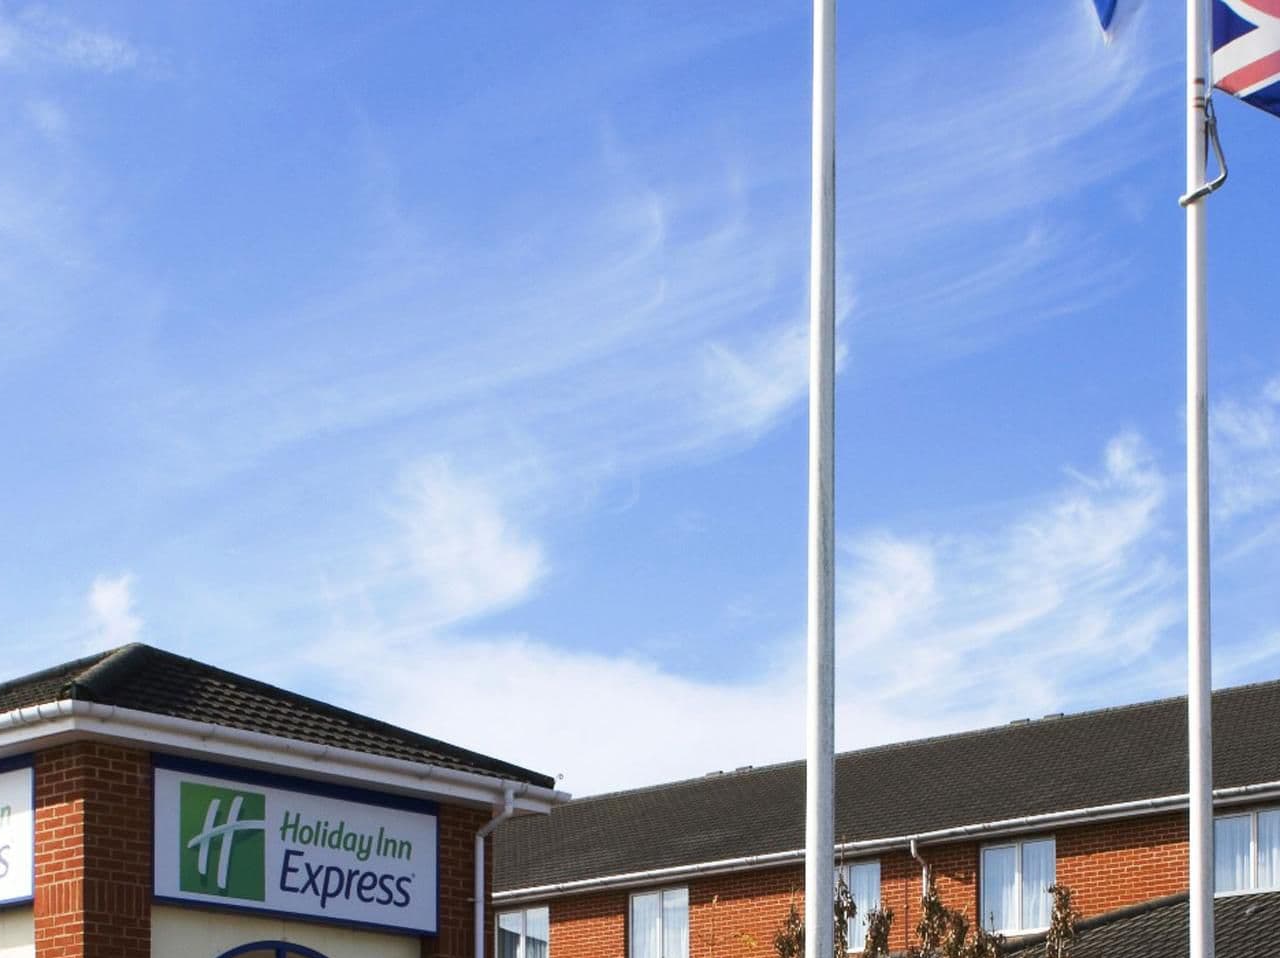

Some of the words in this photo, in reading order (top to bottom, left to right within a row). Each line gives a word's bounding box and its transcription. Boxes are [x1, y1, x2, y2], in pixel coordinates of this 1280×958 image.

[280, 811, 373, 862] Holiday
[376, 827, 412, 861] Inn
[279, 849, 412, 909] Express
